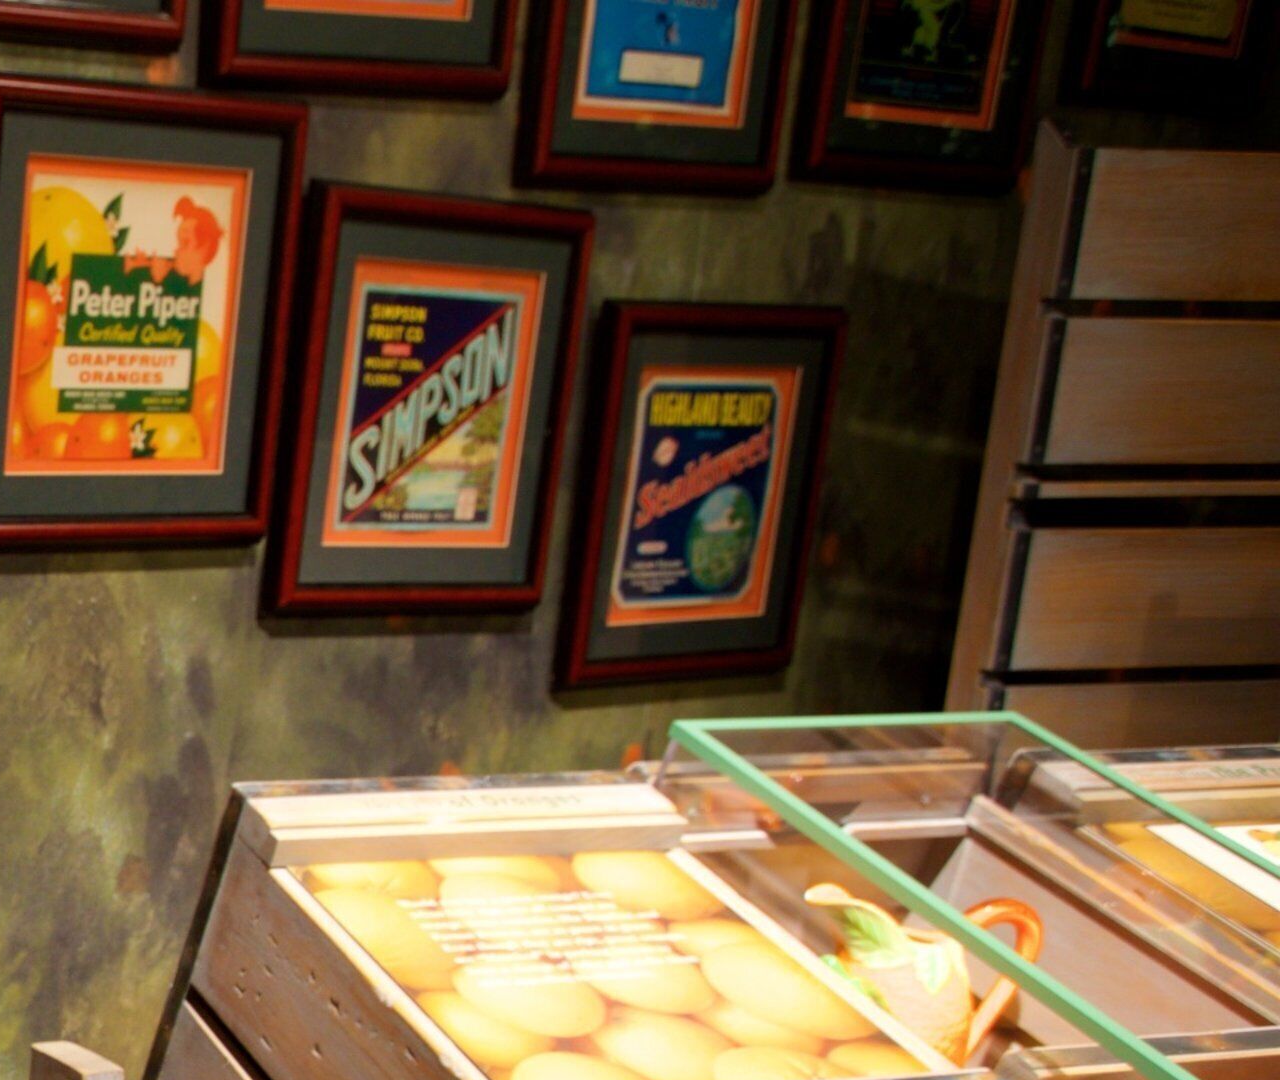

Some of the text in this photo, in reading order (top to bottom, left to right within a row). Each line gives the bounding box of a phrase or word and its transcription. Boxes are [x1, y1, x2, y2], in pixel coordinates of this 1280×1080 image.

[70, 279, 200, 327] Peter Piper
[369, 303, 428, 323] SIMPSON
[78, 322, 185, 346] Certified Quality
[67, 353, 178, 367] GRAPEFRUIT
[79, 372, 163, 385] ORANGES
[344, 305, 514, 510] SIMPSON
